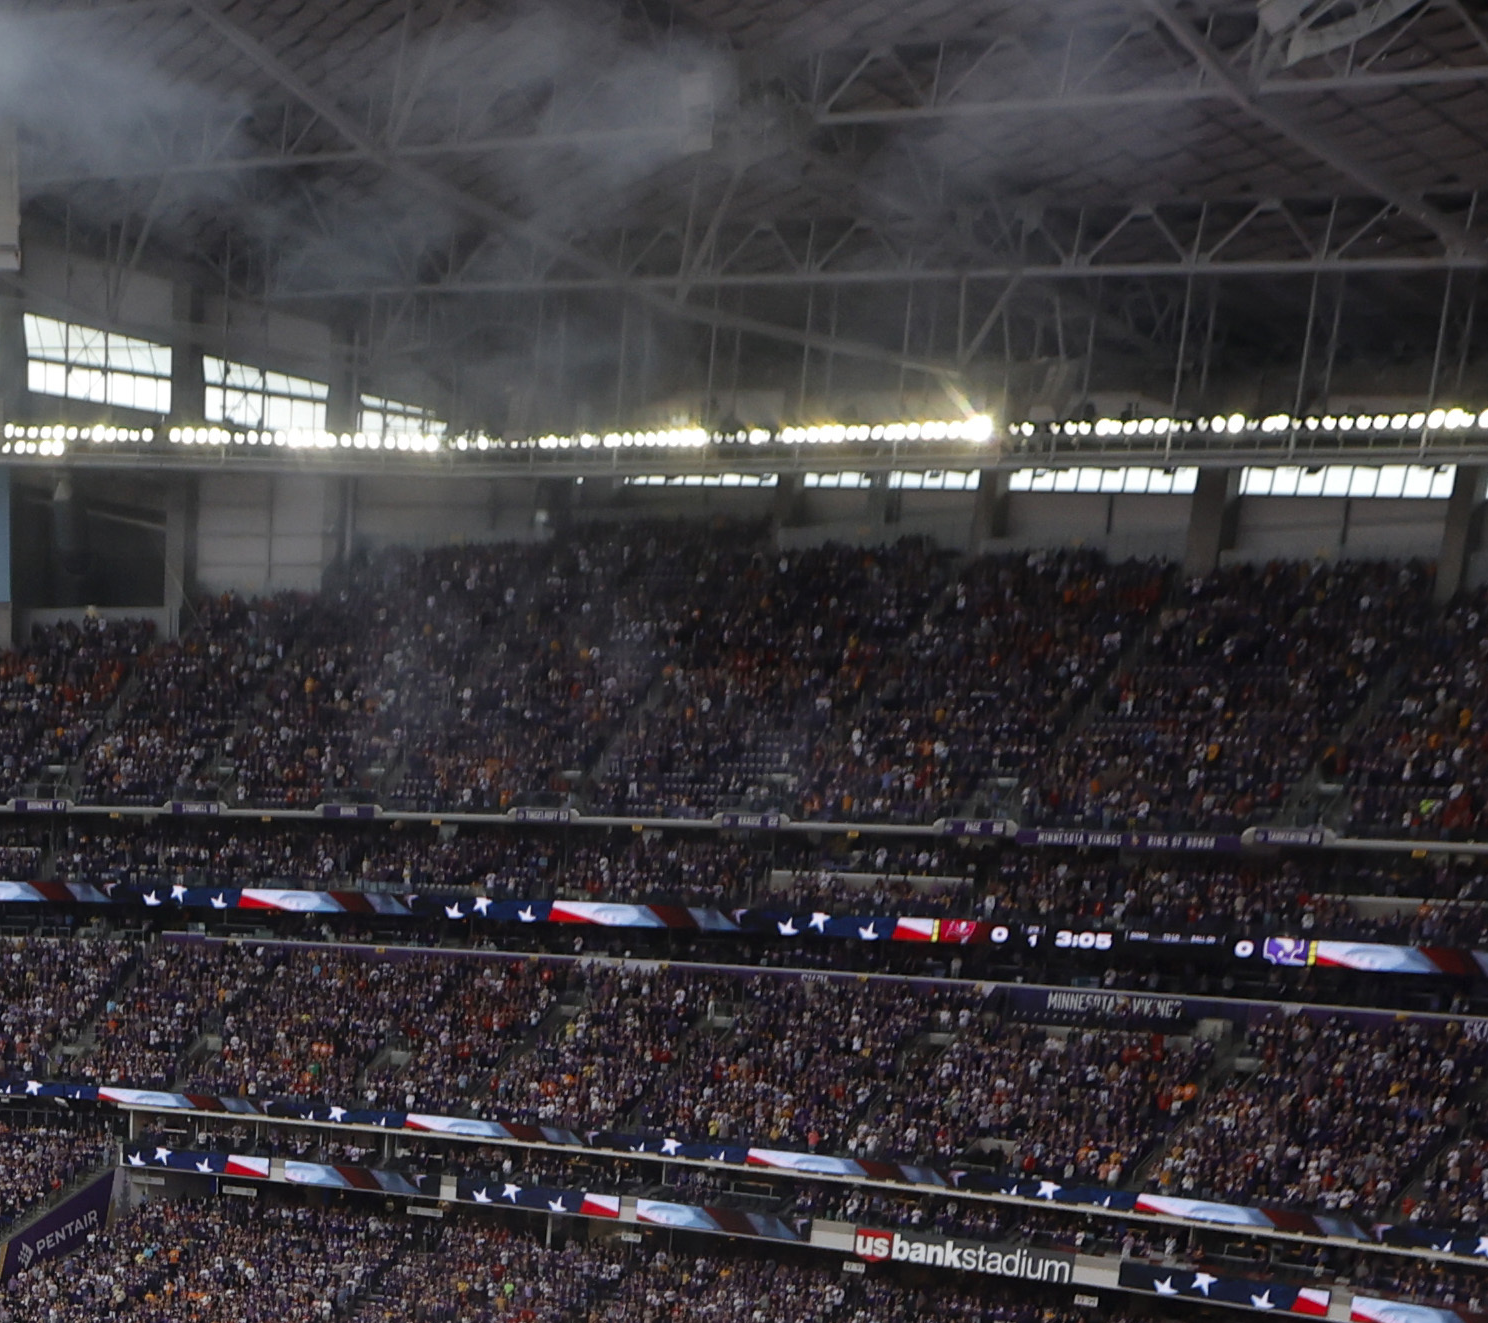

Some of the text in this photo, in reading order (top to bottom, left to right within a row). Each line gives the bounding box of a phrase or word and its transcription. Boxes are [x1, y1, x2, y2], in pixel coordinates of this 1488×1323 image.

[1037, 831, 1122, 845] MINNESOTA VIKINGS
[1147, 834, 1215, 849] RING OF HONOR
[990, 926, 1008, 943] 0
[1055, 930, 1113, 949] 3:05
[1234, 940, 1254, 958] 0
[35, 1209, 99, 1257] PENTAIR
